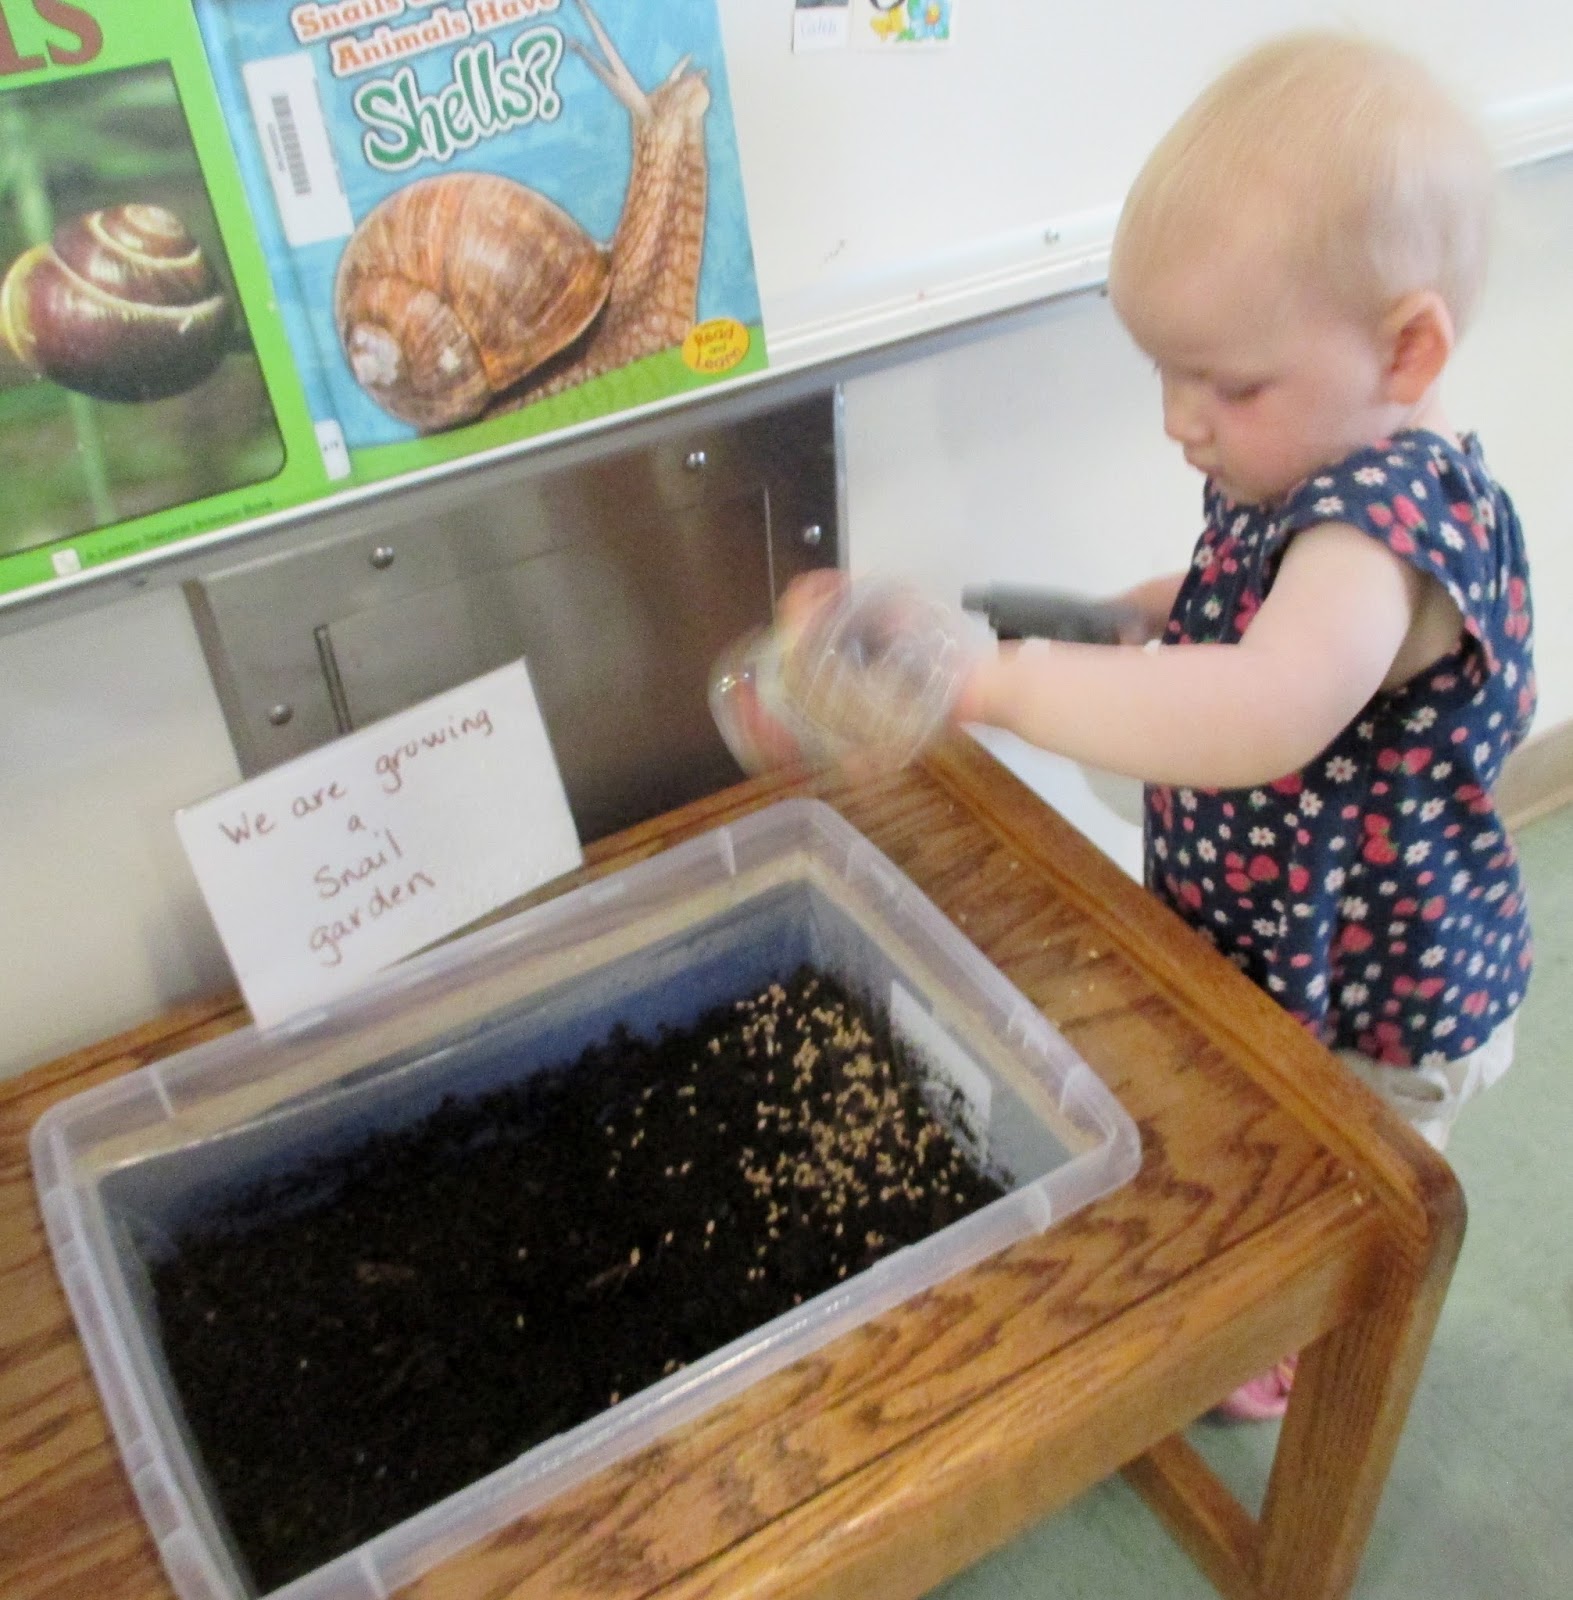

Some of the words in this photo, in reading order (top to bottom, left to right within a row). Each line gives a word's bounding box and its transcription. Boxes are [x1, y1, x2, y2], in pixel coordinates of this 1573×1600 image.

[336, 12, 468, 71] Animals
[473, 0, 556, 27] Hav
[360, 33, 563, 164] Shells?
[218, 811, 277, 845] We
[291, 780, 347, 817] are
[374, 707, 495, 793] growing
[346, 814, 367, 833] a
[308, 870, 437, 967] garden
